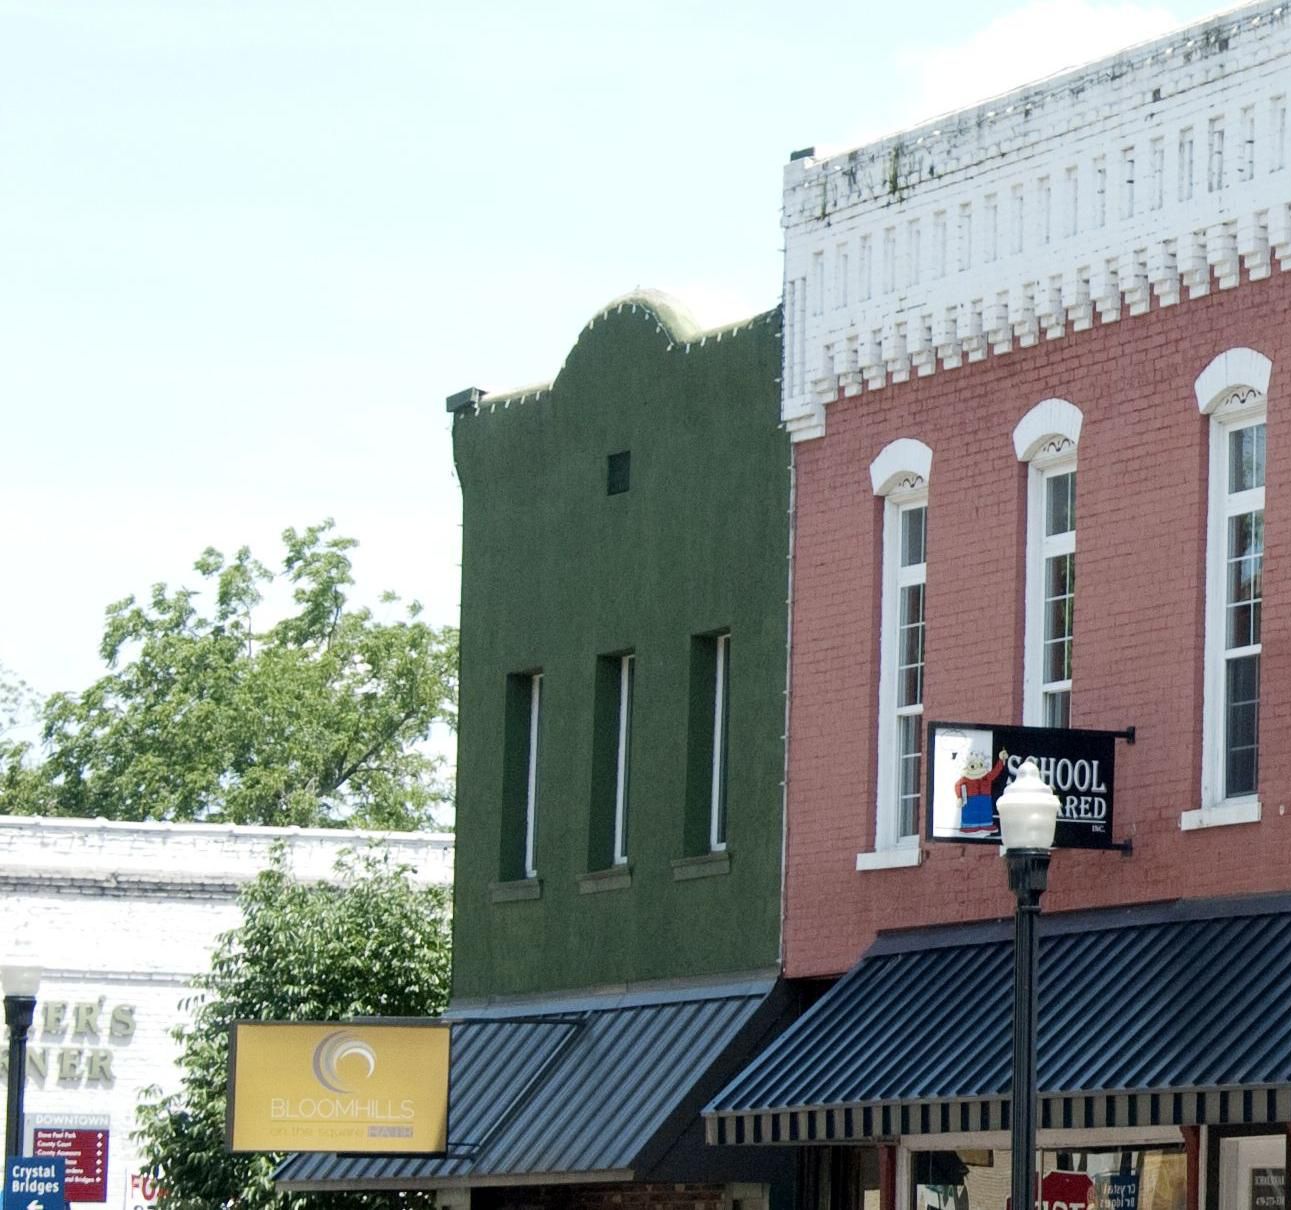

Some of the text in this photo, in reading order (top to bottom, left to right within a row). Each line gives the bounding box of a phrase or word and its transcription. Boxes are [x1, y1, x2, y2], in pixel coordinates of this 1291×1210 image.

[271, 1098, 415, 1120] BLOOMHILLS
[36, 1114, 109, 1126] DOWNTOWN
[12, 1165, 56, 1181] Crystal
[12, 1179, 60, 1196] Bridges
